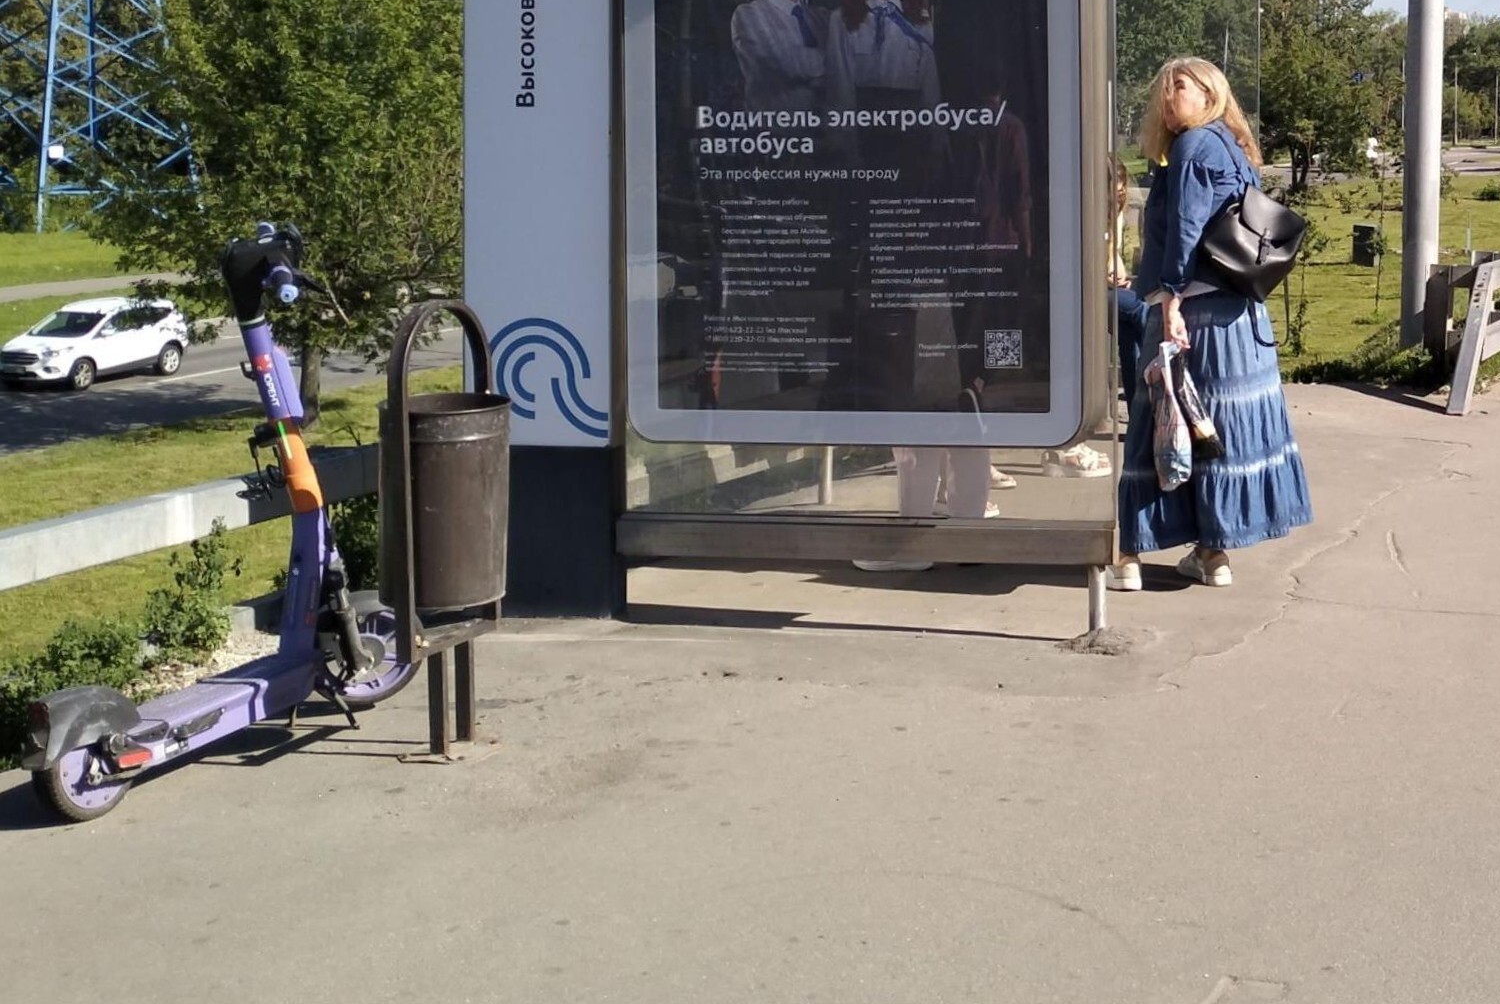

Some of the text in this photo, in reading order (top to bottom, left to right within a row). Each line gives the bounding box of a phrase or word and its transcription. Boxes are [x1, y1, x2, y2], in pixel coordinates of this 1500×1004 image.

[698, 100, 1007, 131] Водитель электробуса/
[700, 132, 814, 159] автобуса
[700, 167, 900, 182] Эта профессия нужна городу
